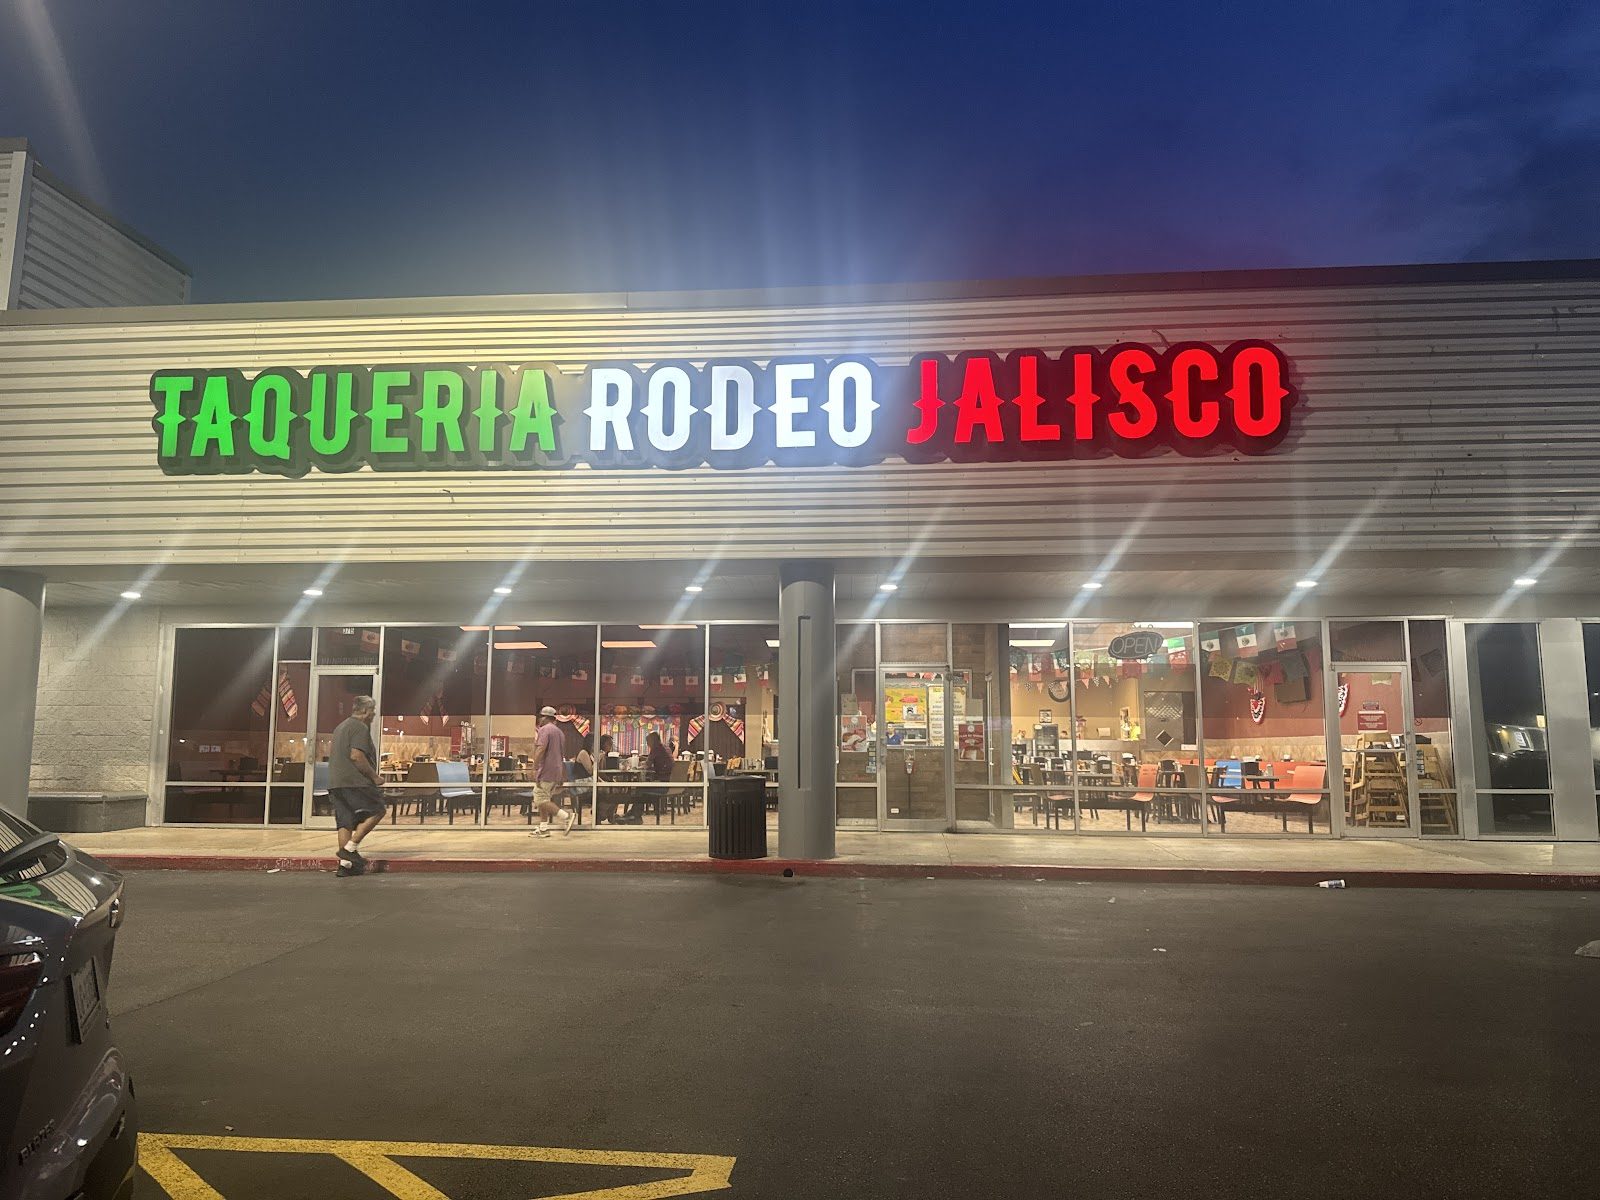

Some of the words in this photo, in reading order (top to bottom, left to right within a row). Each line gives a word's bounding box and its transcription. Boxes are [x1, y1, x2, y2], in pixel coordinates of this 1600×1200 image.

[154, 369, 557, 460] TAQUERIA
[582, 361, 880, 452] RODEO
[906, 347, 1289, 444] JALISCO
[1111, 637, 1159, 654] OPEN
